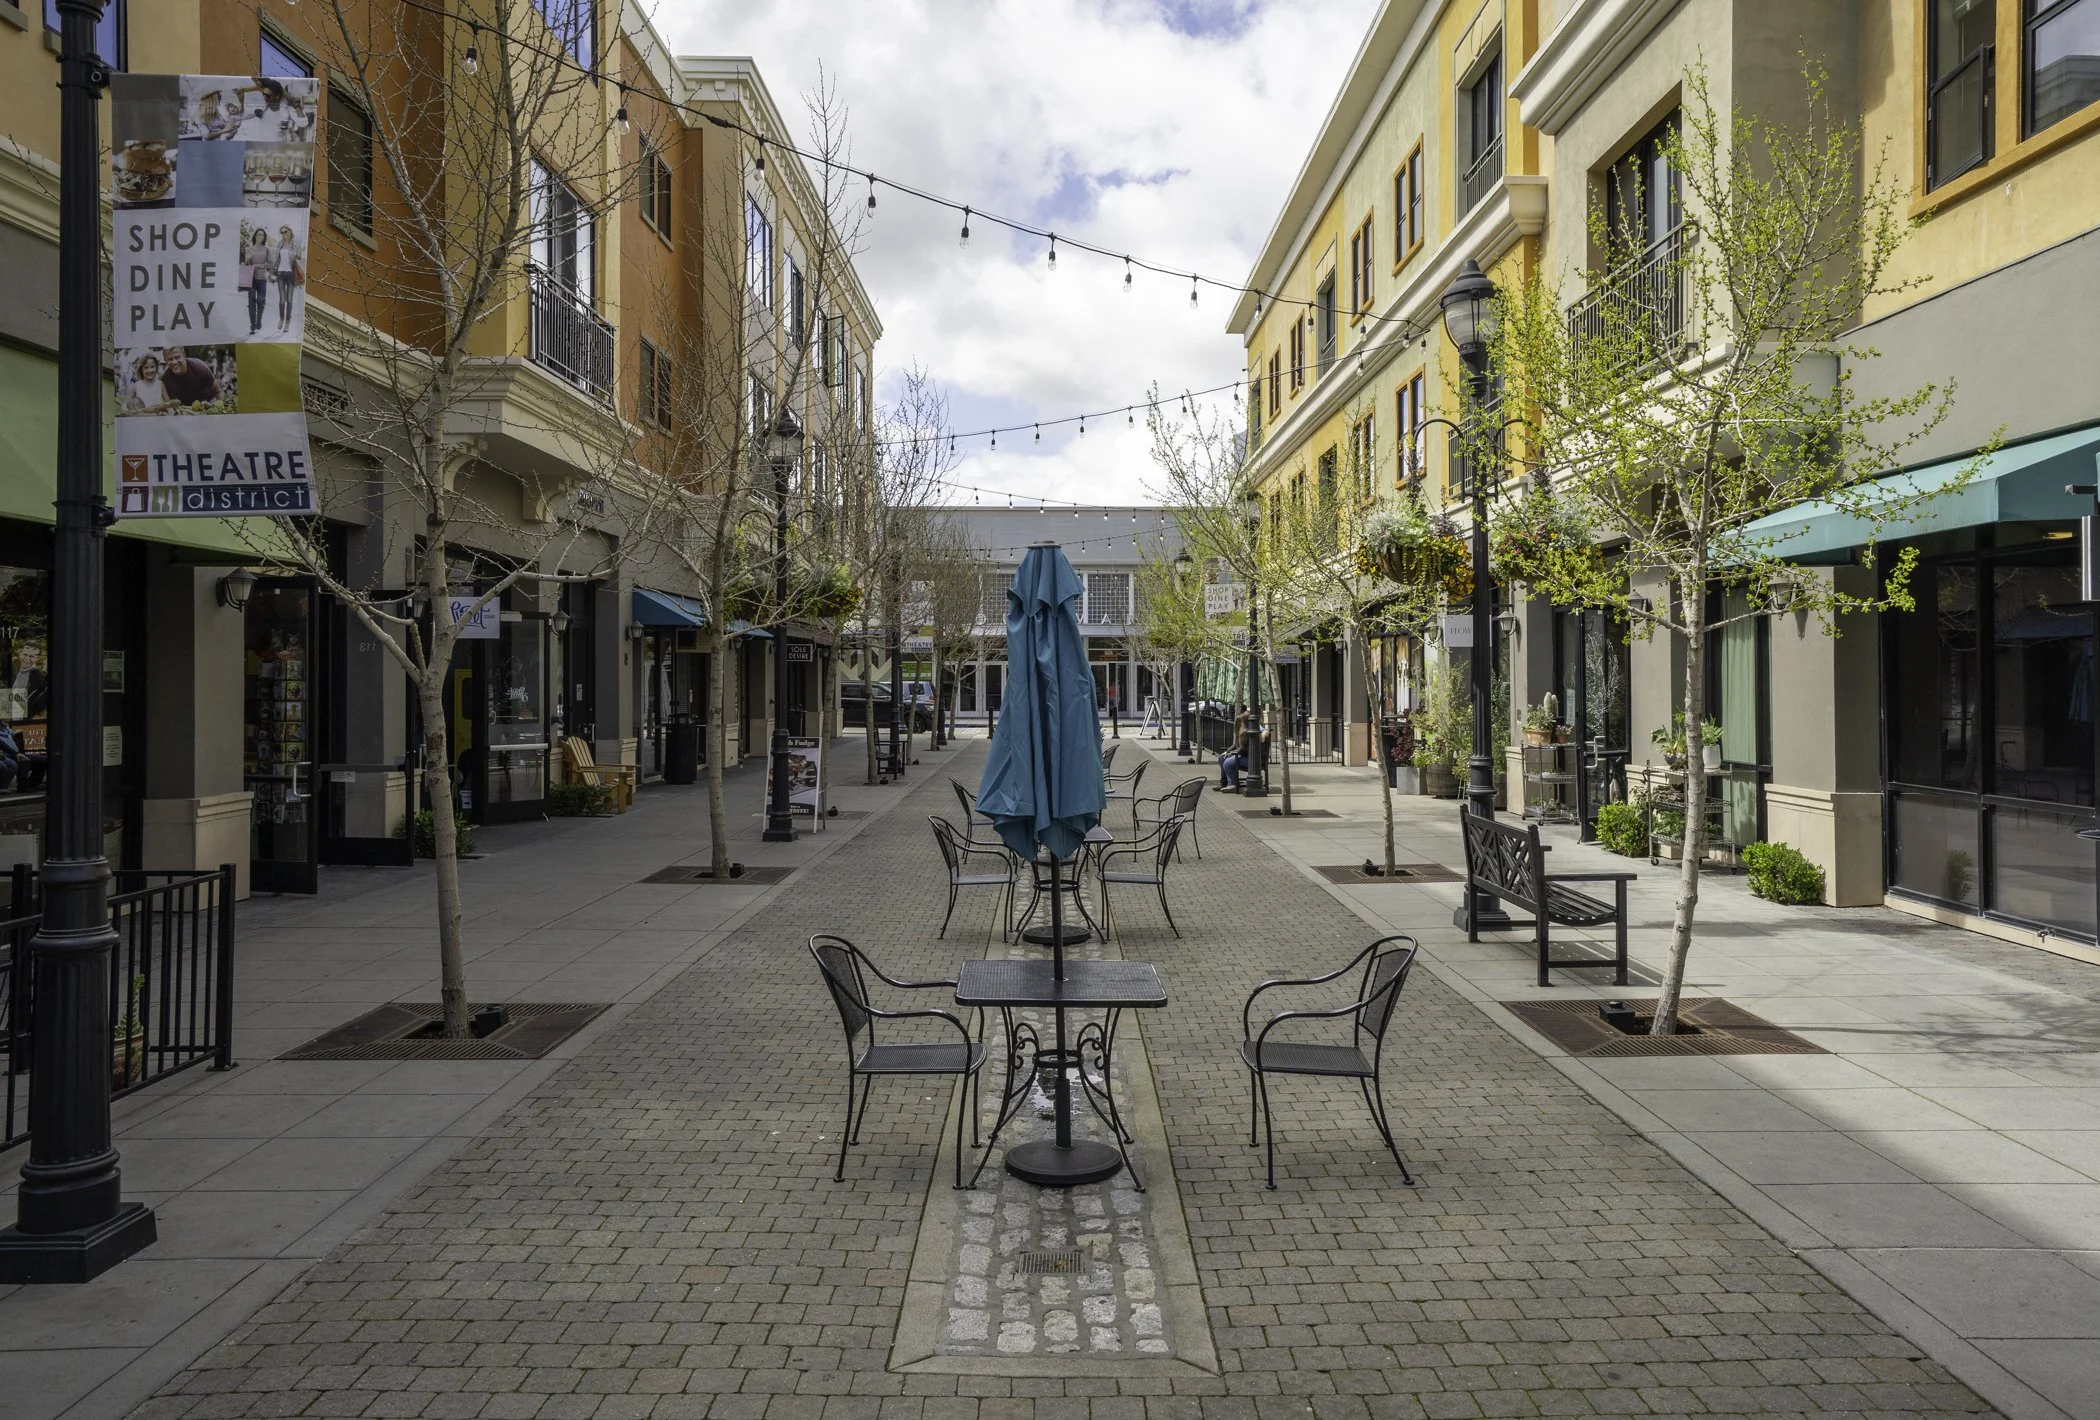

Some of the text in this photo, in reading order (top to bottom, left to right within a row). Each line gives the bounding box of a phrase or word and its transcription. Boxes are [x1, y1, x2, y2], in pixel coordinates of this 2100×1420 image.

[129, 222, 222, 253] SHOP
[130, 261, 217, 292] DINE
[130, 301, 217, 332] PLAY
[153, 450, 307, 483] THEATRE
[187, 484, 306, 511] district
[1208, 586, 1229, 594] SHOP
[794, 739, 815, 748] Fudge
